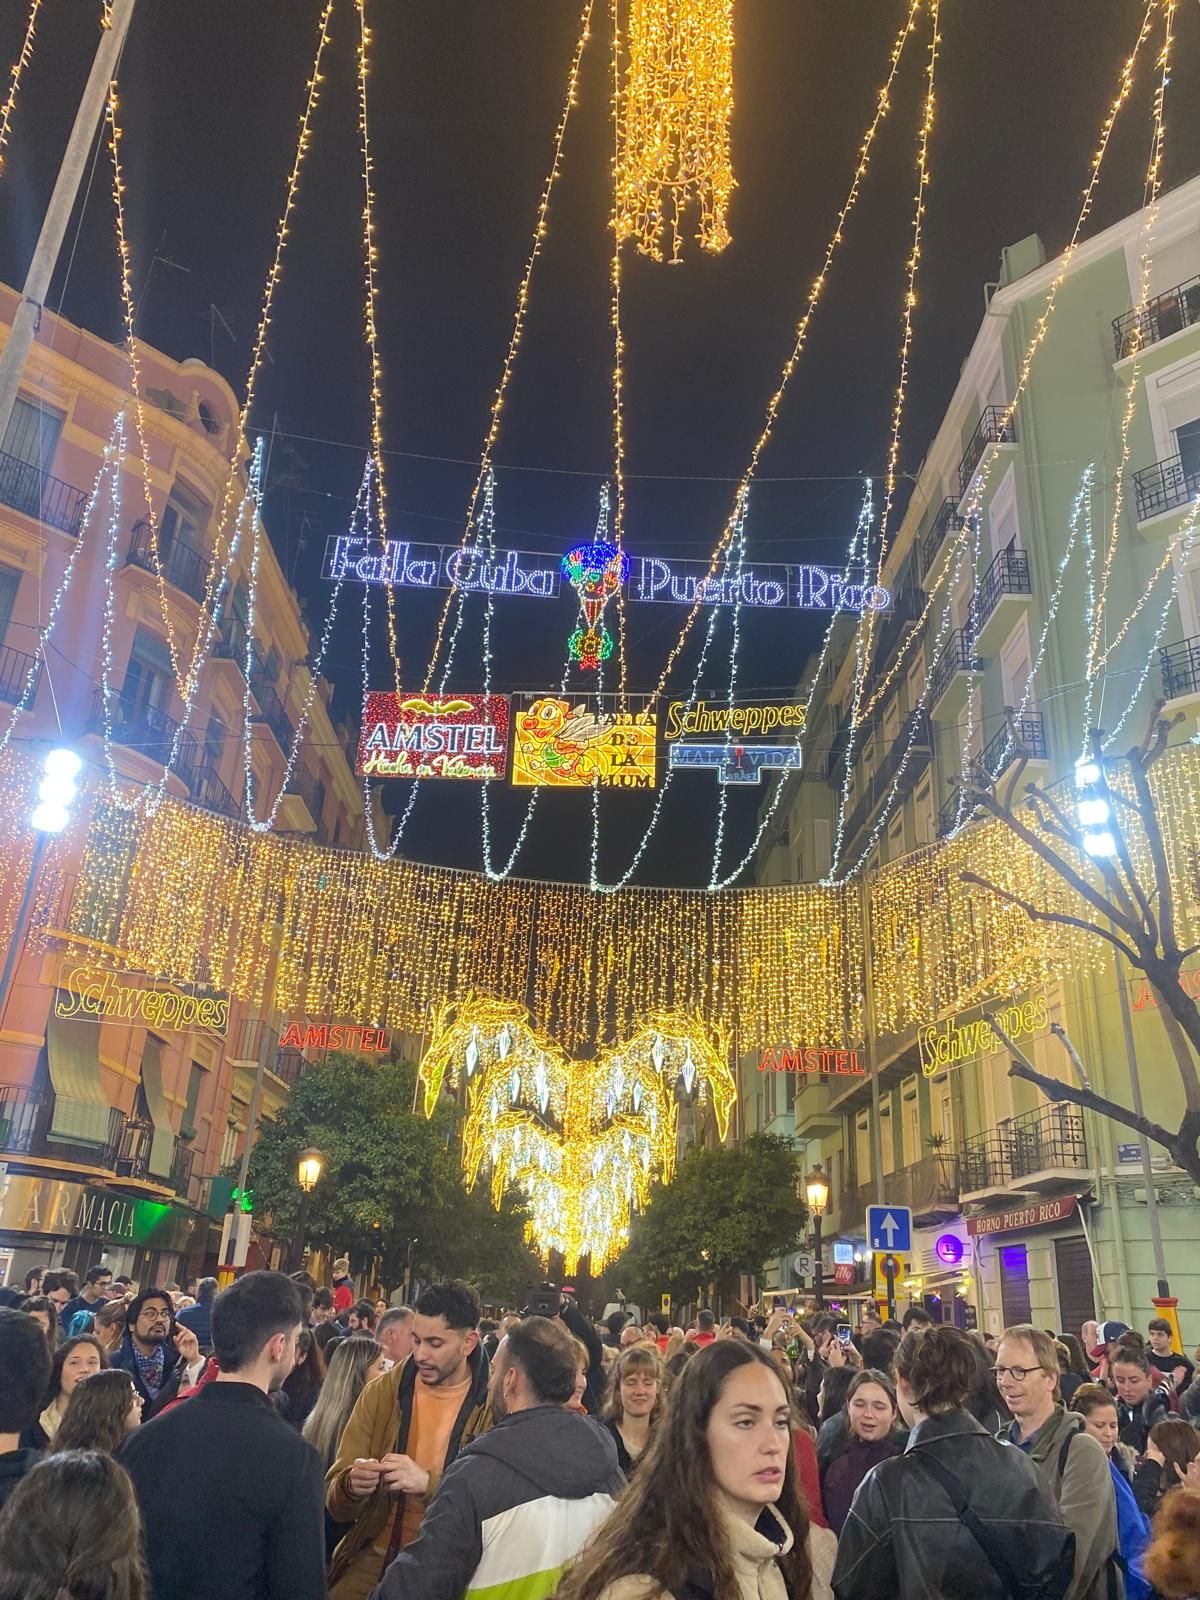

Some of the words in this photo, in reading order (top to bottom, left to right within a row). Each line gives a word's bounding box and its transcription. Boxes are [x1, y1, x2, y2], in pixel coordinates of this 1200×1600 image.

[330, 536, 437, 584] Falla
[446, 548, 555, 596] Cuba
[637, 558, 784, 605] Puerto
[797, 565, 890, 610] Rico
[664, 701, 807, 739] Schweppes
[366, 722, 503, 753] AMSTEL
[611, 733, 638, 746] DE
[611, 752, 637, 766] LA
[745, 750, 800, 766] VIDA
[57, 967, 228, 1031] Schweppes
[278, 1023, 389, 1053] AMSTEL
[757, 1046, 865, 1075] AMSTEL
[17, 1188, 136, 1237] ARMACIA
[976, 1217, 1000, 1233] HORNO
[1004, 1208, 1035, 1229] PUERTO
[1039, 1202, 1060, 1221] RICO
[835, 1266, 852, 1282] illy
